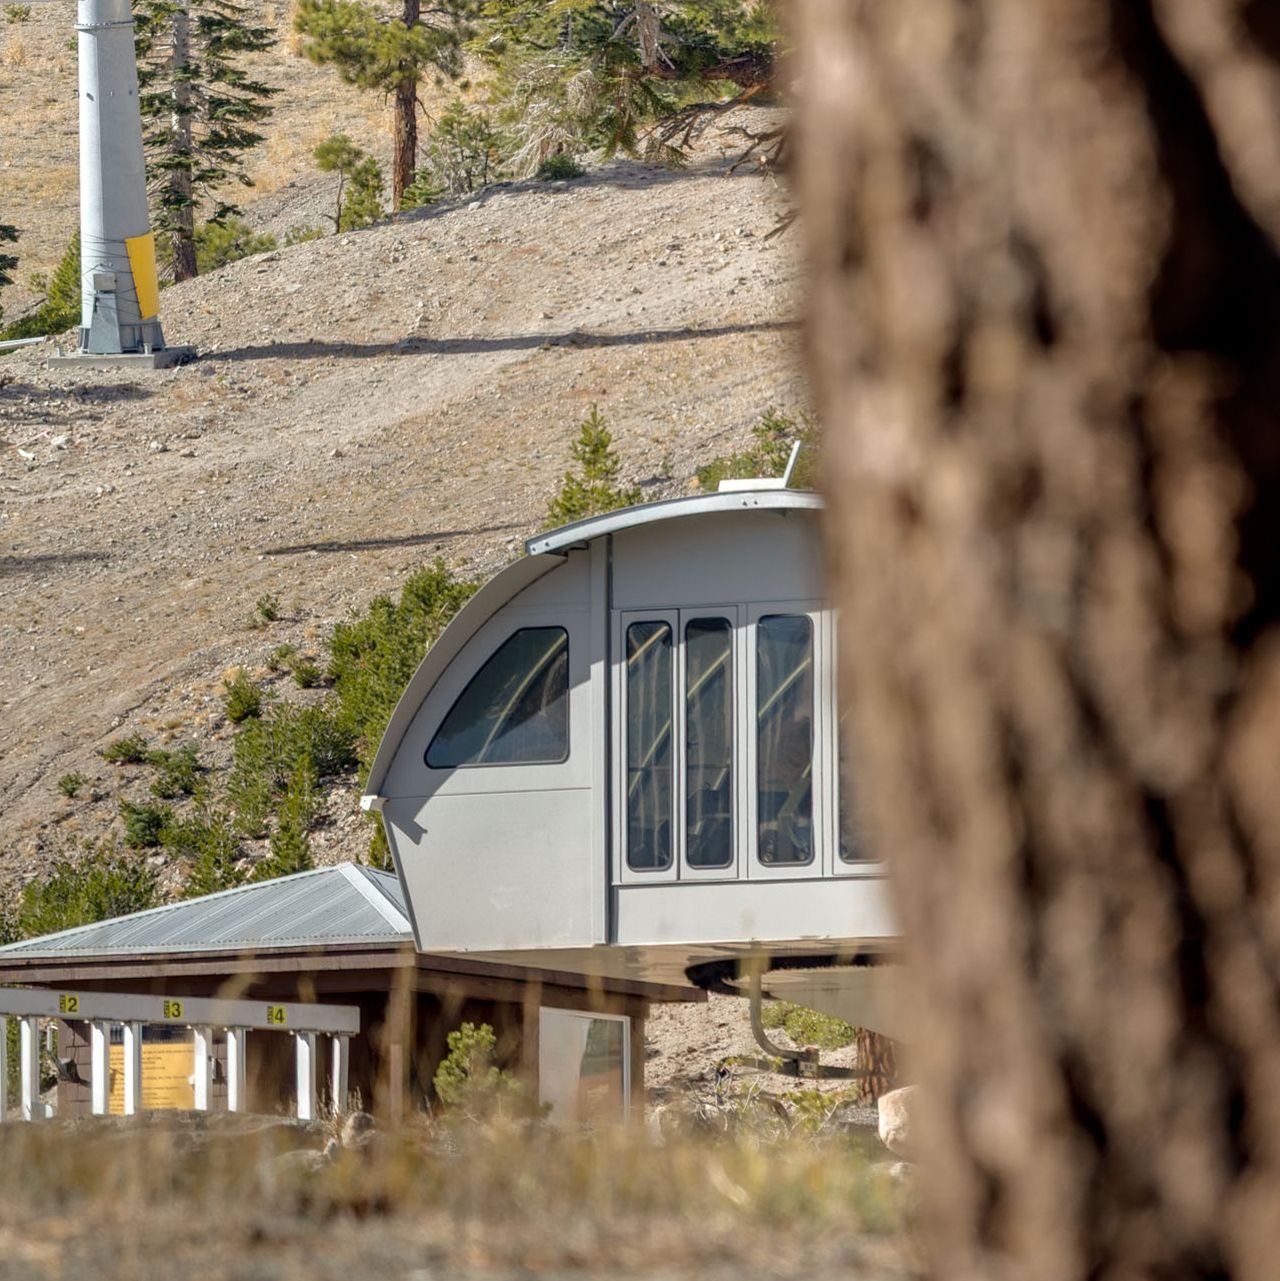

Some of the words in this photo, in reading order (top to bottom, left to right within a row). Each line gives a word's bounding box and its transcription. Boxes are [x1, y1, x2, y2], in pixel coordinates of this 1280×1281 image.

[68, 997, 78, 1012] 2
[171, 1002, 181, 1018] 3
[274, 1008, 285, 1024] 4
